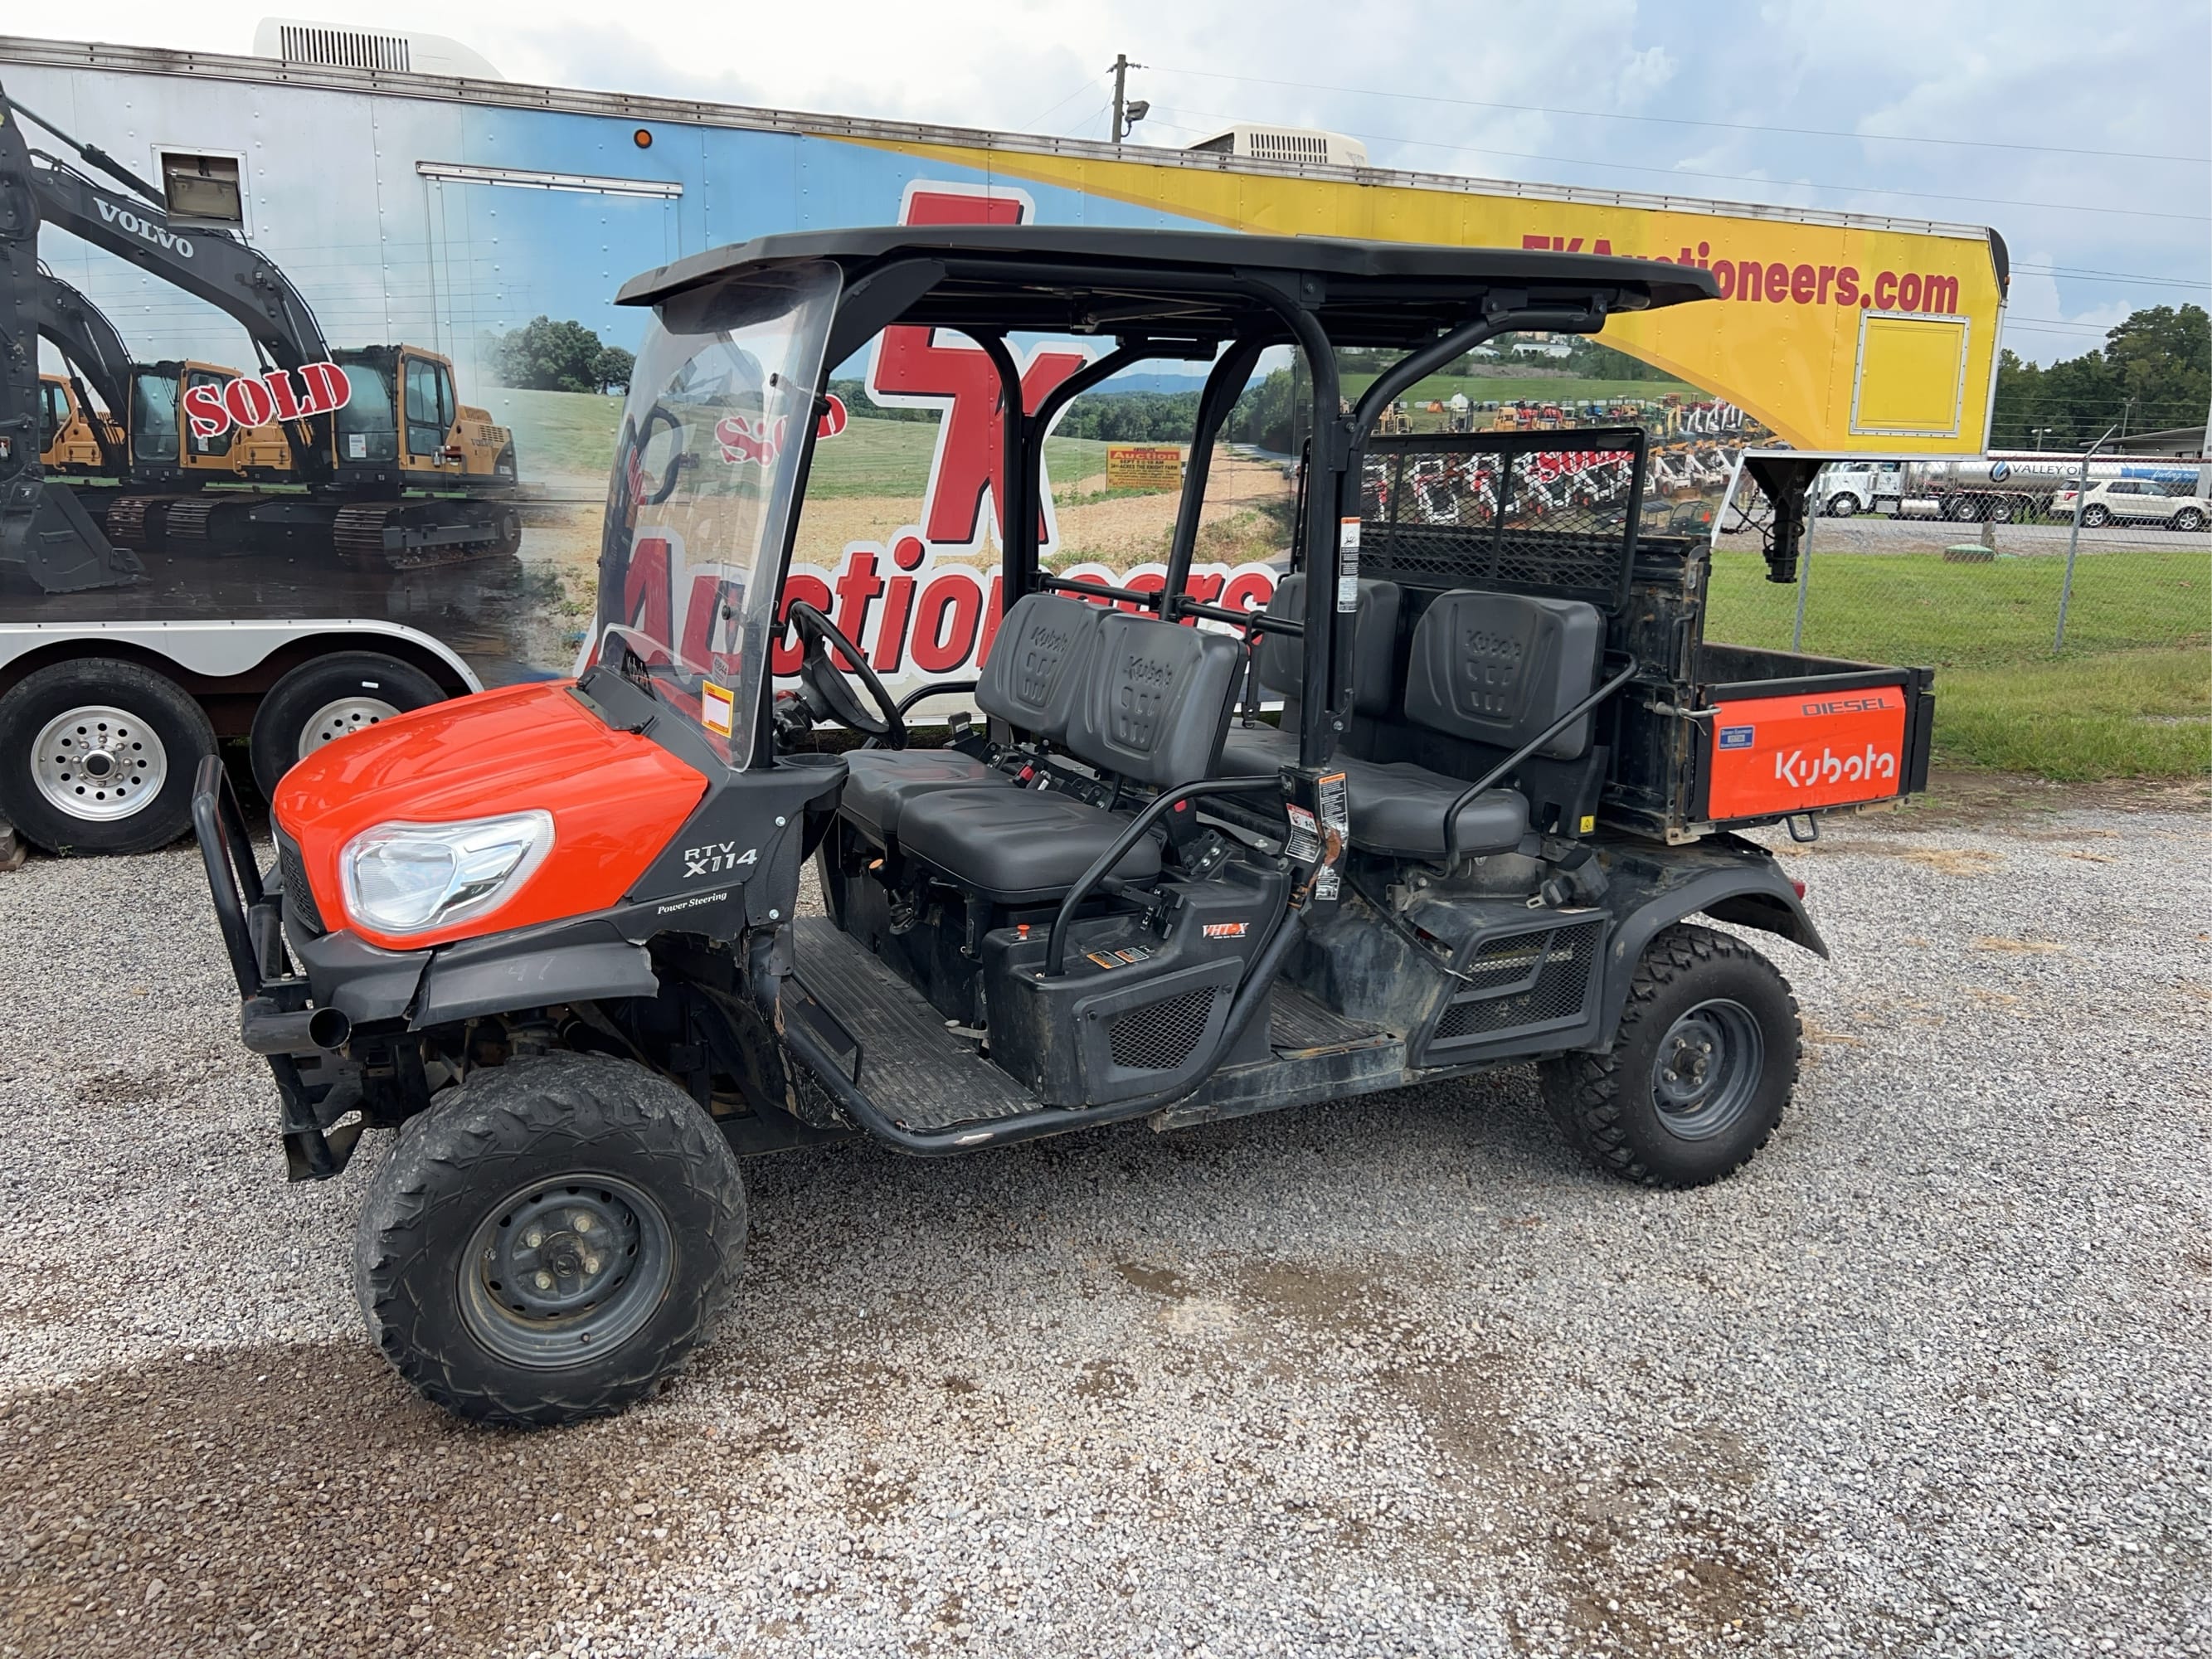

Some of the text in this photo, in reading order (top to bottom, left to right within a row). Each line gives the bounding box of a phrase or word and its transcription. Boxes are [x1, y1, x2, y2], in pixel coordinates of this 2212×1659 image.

[93, 197, 194, 259] VOLVO
[183, 362, 351, 439] SOLD
[1113, 451, 1178, 460] Auction
[2012, 465, 2063, 474] VALLEY
[1801, 698, 1895, 717] DIESEL
[1775, 744, 1895, 788] Kubota
[684, 841, 735, 861] RTV
[657, 893, 728, 914] Power Steering
